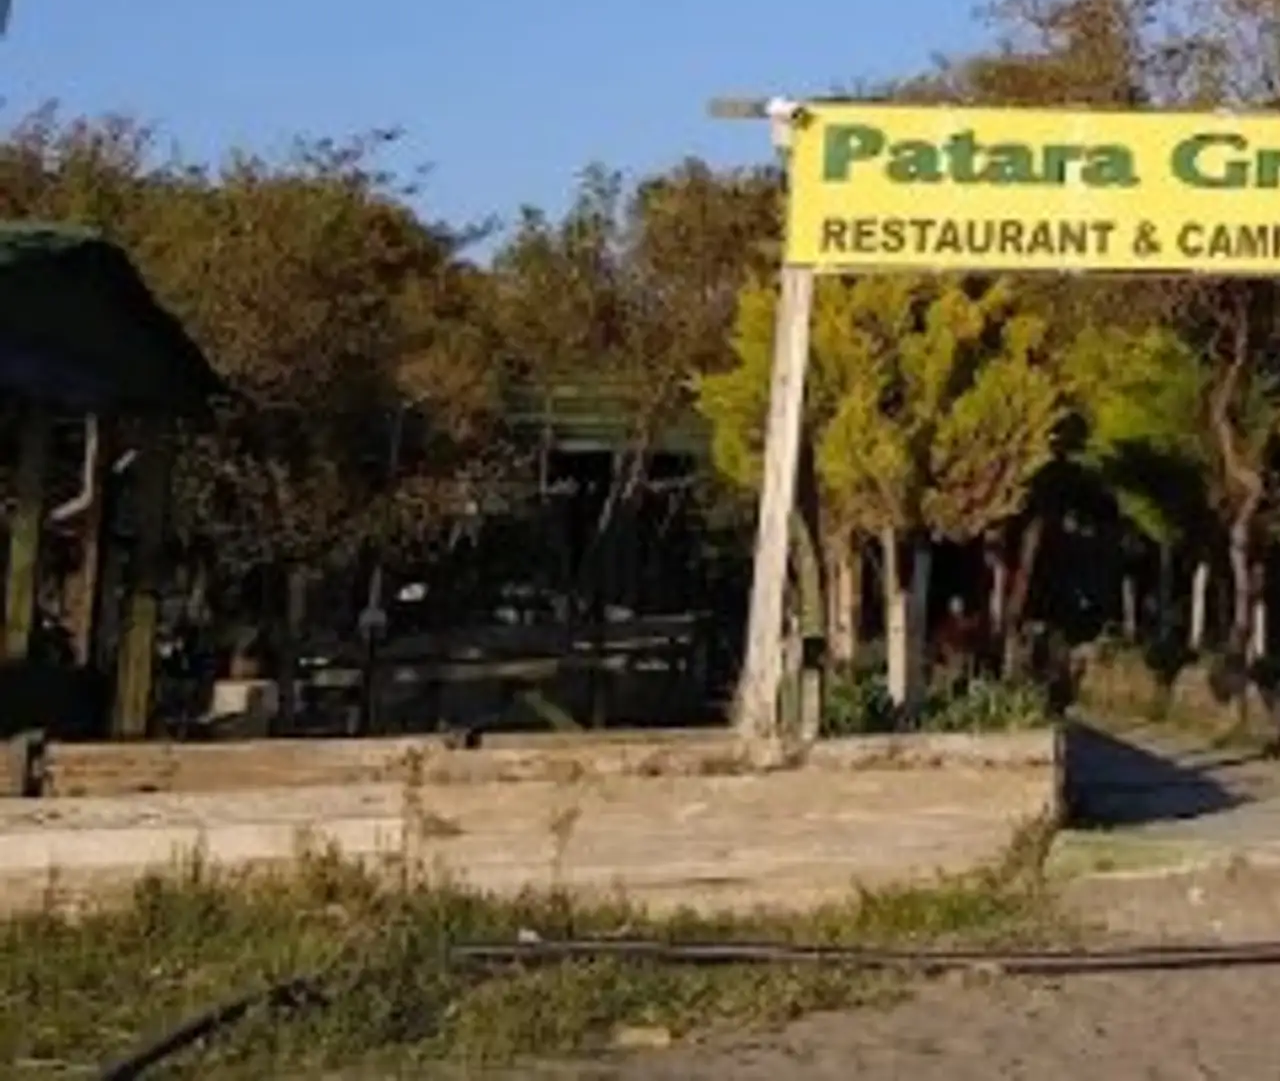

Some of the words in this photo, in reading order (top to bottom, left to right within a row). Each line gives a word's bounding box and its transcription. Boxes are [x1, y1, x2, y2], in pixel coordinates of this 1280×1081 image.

[822, 123, 1141, 188] Patara
[820, 218, 1115, 256] RESTAURANT
[1133, 221, 1161, 258] &
